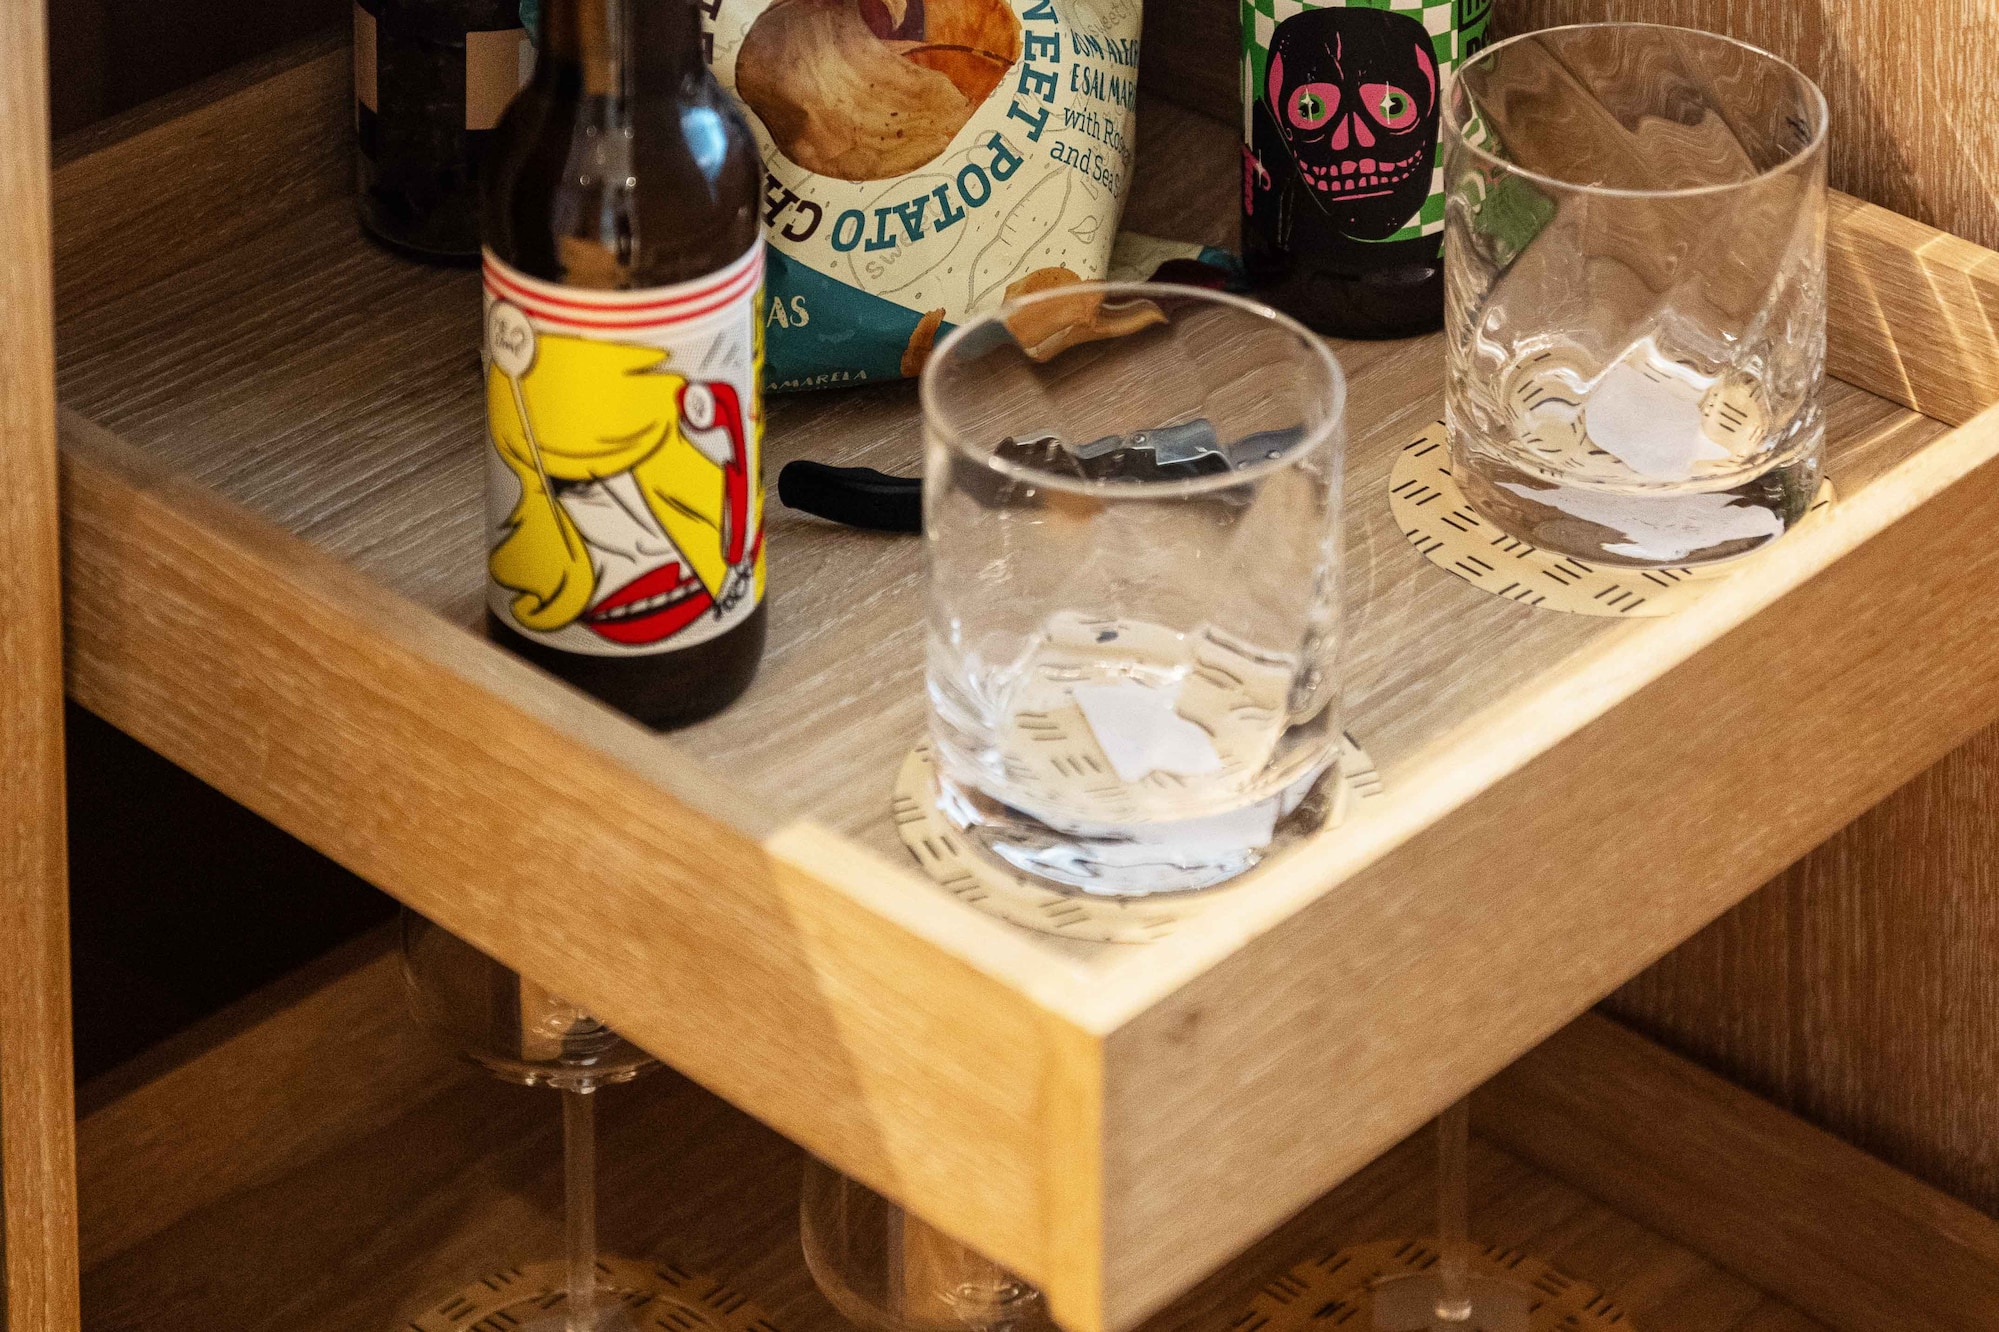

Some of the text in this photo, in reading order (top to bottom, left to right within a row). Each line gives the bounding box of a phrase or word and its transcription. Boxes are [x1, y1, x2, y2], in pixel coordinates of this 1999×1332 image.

[1081, 66, 1105, 102] SAL
[1063, 107, 1100, 141] with
[1049, 140, 1092, 174] and
[831, 132, 1026, 253] POTATO
